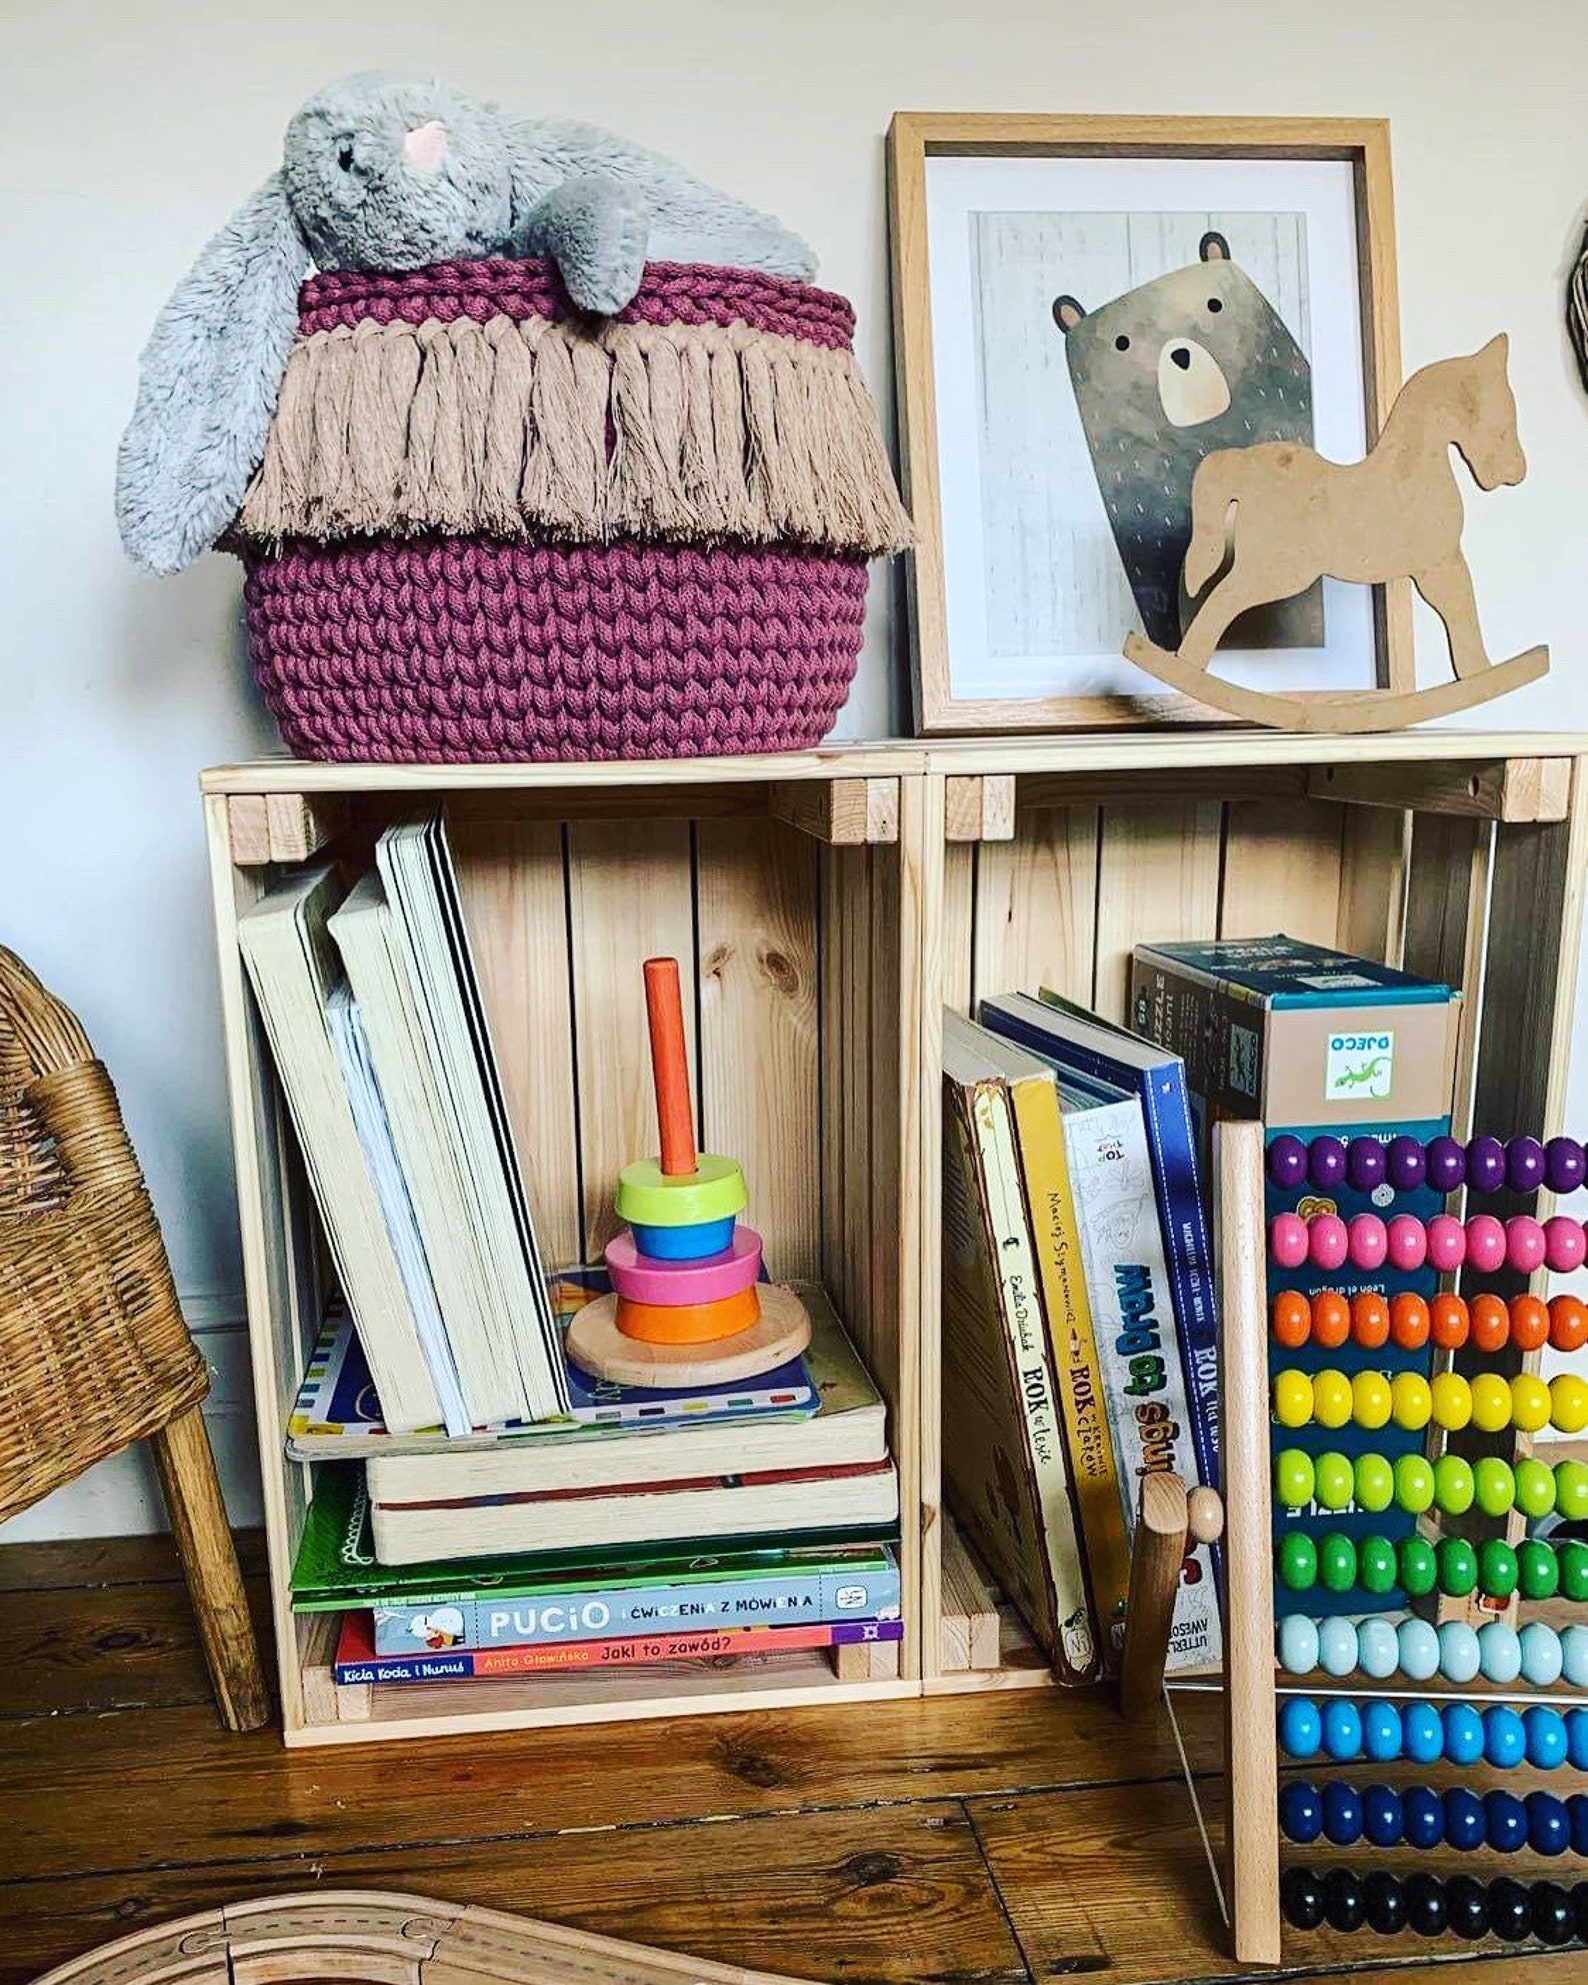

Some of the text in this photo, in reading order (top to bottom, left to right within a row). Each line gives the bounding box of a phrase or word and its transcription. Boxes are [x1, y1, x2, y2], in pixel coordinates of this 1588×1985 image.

[1154, 973, 1165, 1045] UZZLE
[1331, 1036, 1390, 1050] DJECO
[1113, 1264, 1180, 1477] ings to Draw
[1194, 1344, 1217, 1397] ROK
[1023, 1366, 1049, 1414] ROK
[1070, 1364, 1095, 1413] ROK
[721, 1601, 730, 1613] Z
[1171, 1618, 1208, 1637] AWESO
[484, 1655, 518, 1669] Anita
[643, 1644, 661, 1657] to
[669, 1637, 731, 1655] zawód?
[1167, 1635, 1208, 1654] UTTERL
[415, 1665, 419, 1678] i
